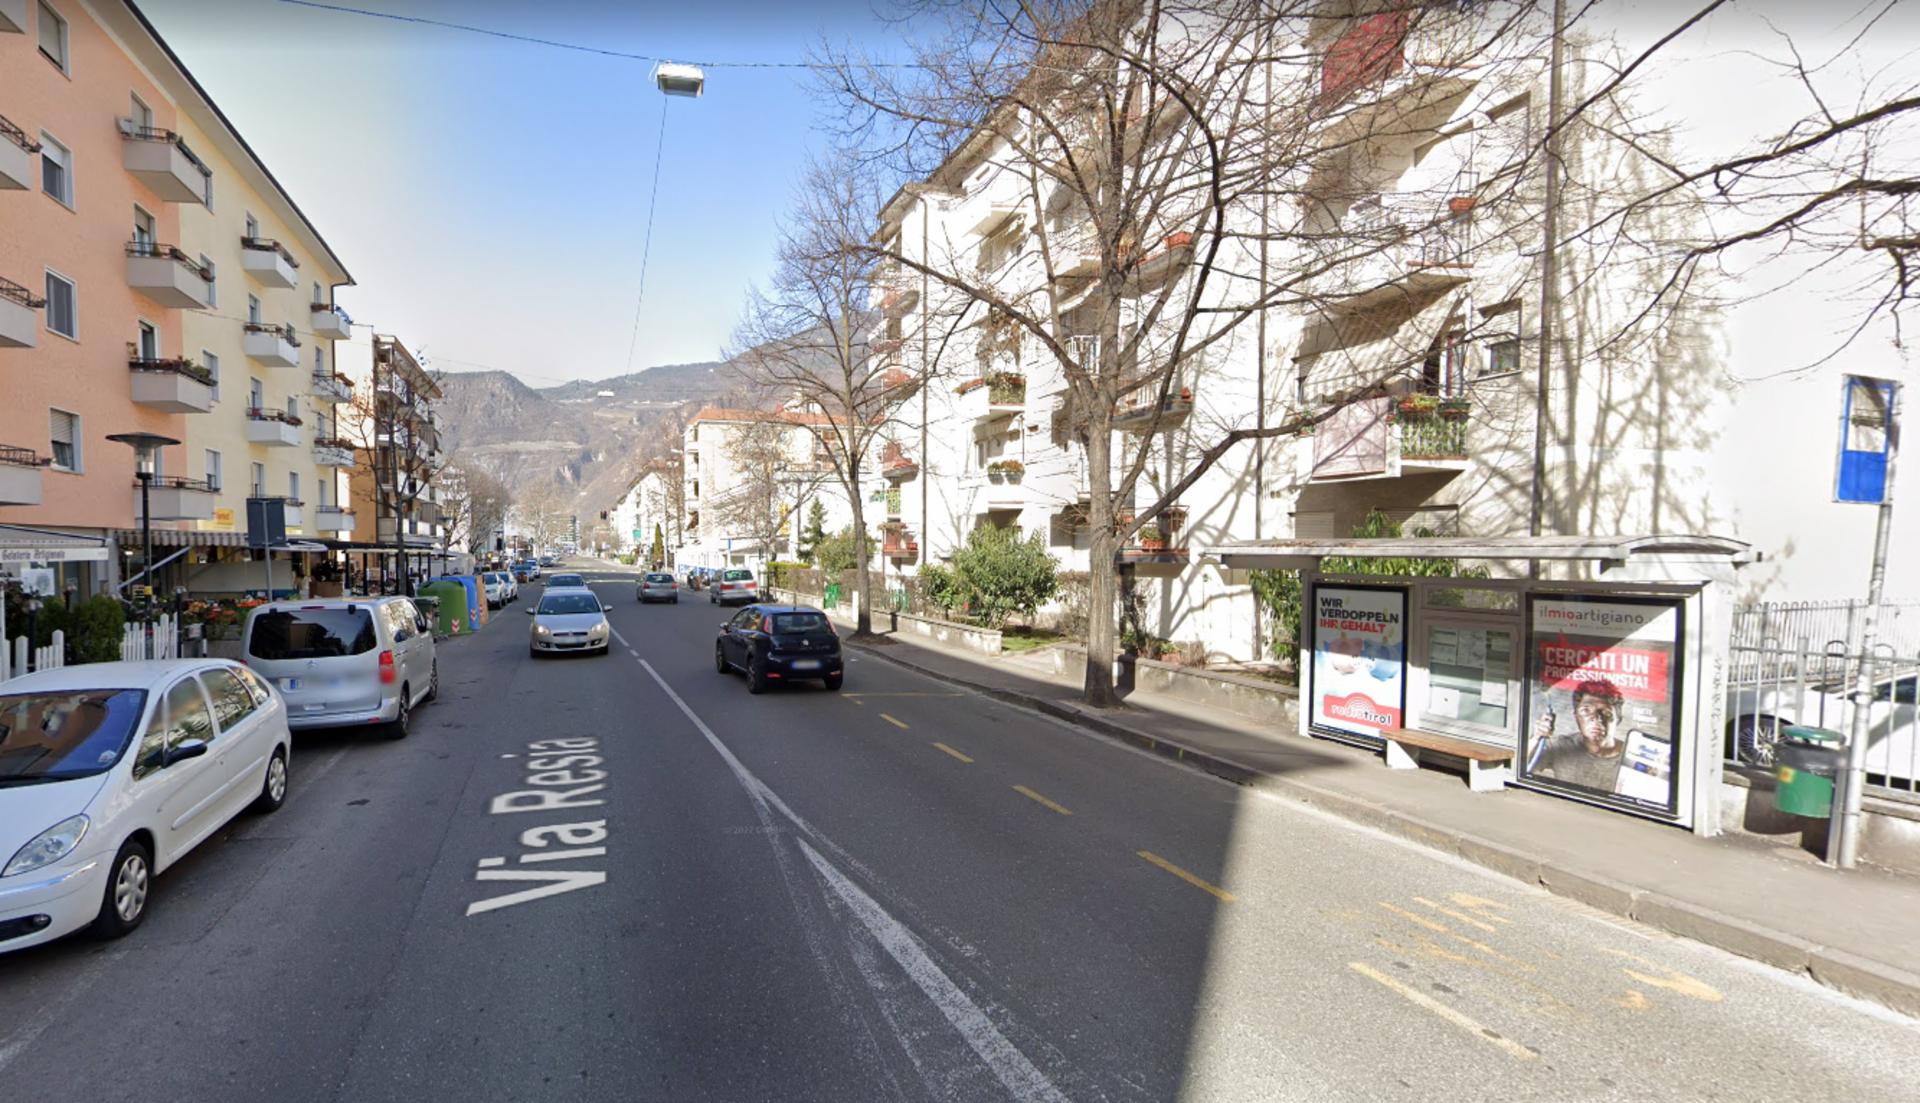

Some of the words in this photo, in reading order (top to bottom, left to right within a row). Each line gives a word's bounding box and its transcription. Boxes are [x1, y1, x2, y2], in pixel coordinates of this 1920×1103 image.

[1320, 597, 1343, 608] WIR
[1320, 608, 1399, 623] VERDOPPELN
[1539, 606, 1644, 626] ilmioartigiano
[1320, 618, 1339, 630] IHR
[1340, 620, 1386, 633] GEHALT
[1544, 647, 1616, 671] CERCATI
[1621, 653, 1650, 675] UN
[1544, 664, 1649, 689] PROFESSIONISTA!
